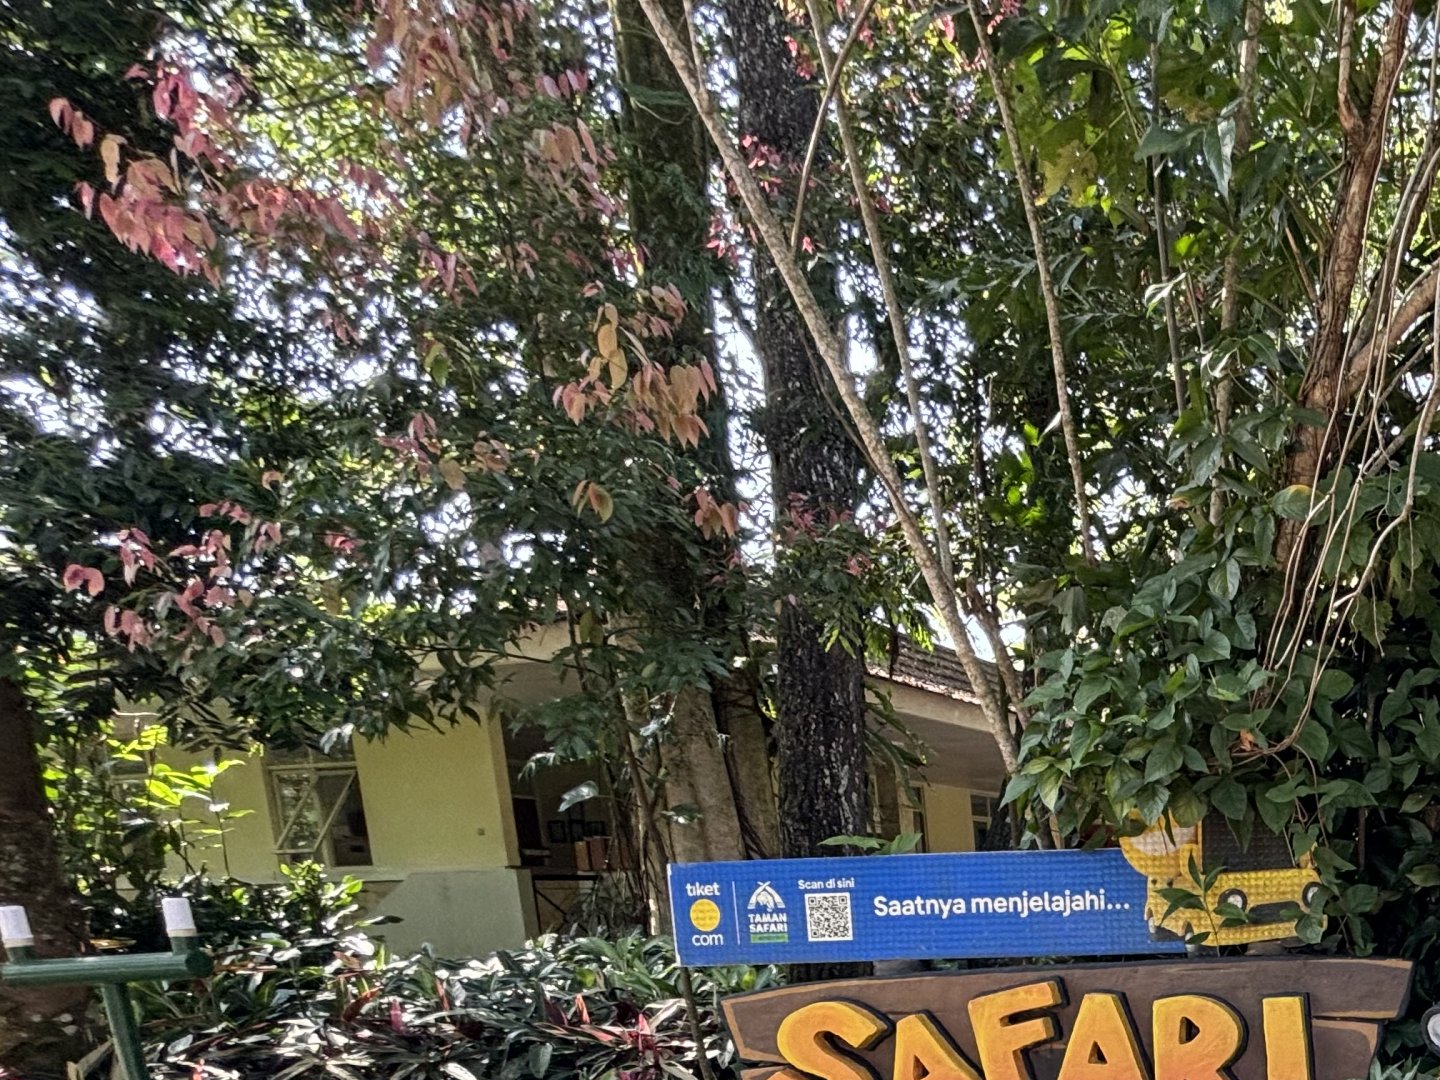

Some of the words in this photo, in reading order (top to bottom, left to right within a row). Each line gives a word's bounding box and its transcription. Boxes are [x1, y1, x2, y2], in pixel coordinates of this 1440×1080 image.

[798, 879, 823, 890] Scan
[825, 878, 836, 889] di
[837, 877, 855, 889] sini
[873, 896, 967, 919] Saatnya
[970, 889, 1130, 918] menjelajahi...
[747, 912, 788, 924] TAMAN
[749, 922, 788, 933] SAFARI
[691, 933, 724, 946] com
